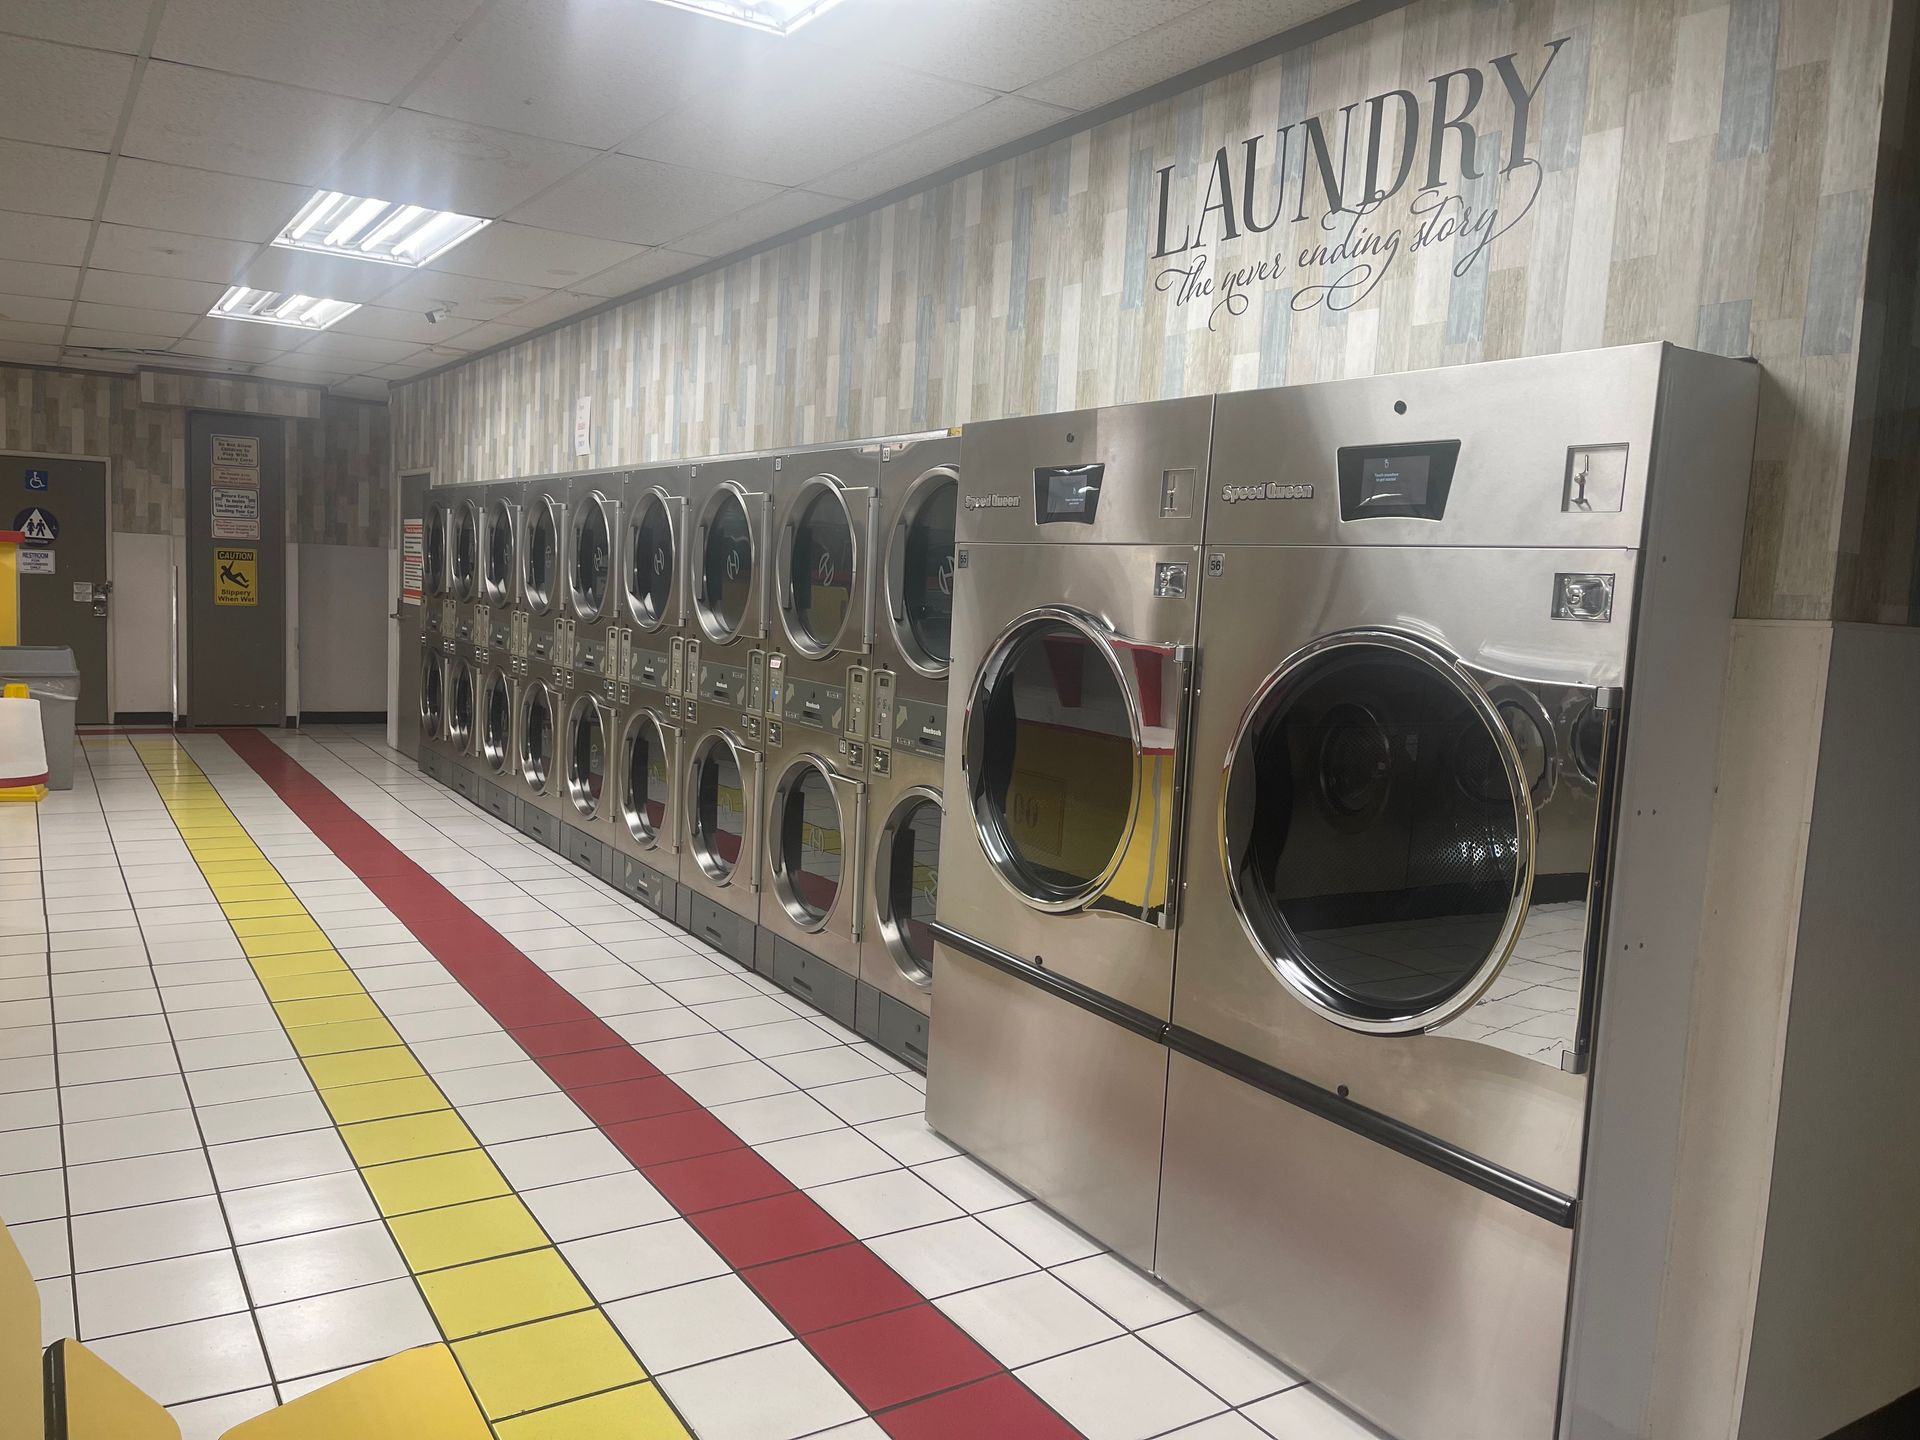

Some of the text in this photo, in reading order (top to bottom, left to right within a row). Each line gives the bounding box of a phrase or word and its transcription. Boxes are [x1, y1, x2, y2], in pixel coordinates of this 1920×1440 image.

[1151, 36, 1571, 259] LAUNDRY
[1155, 157, 1543, 332] the never ending story
[1222, 481, 1314, 504] Speed Queen
[965, 494, 1021, 511] Speed Queen
[219, 551, 253, 560] CAUTION
[960, 554, 967, 564] 55
[1210, 560, 1221, 571] 56
